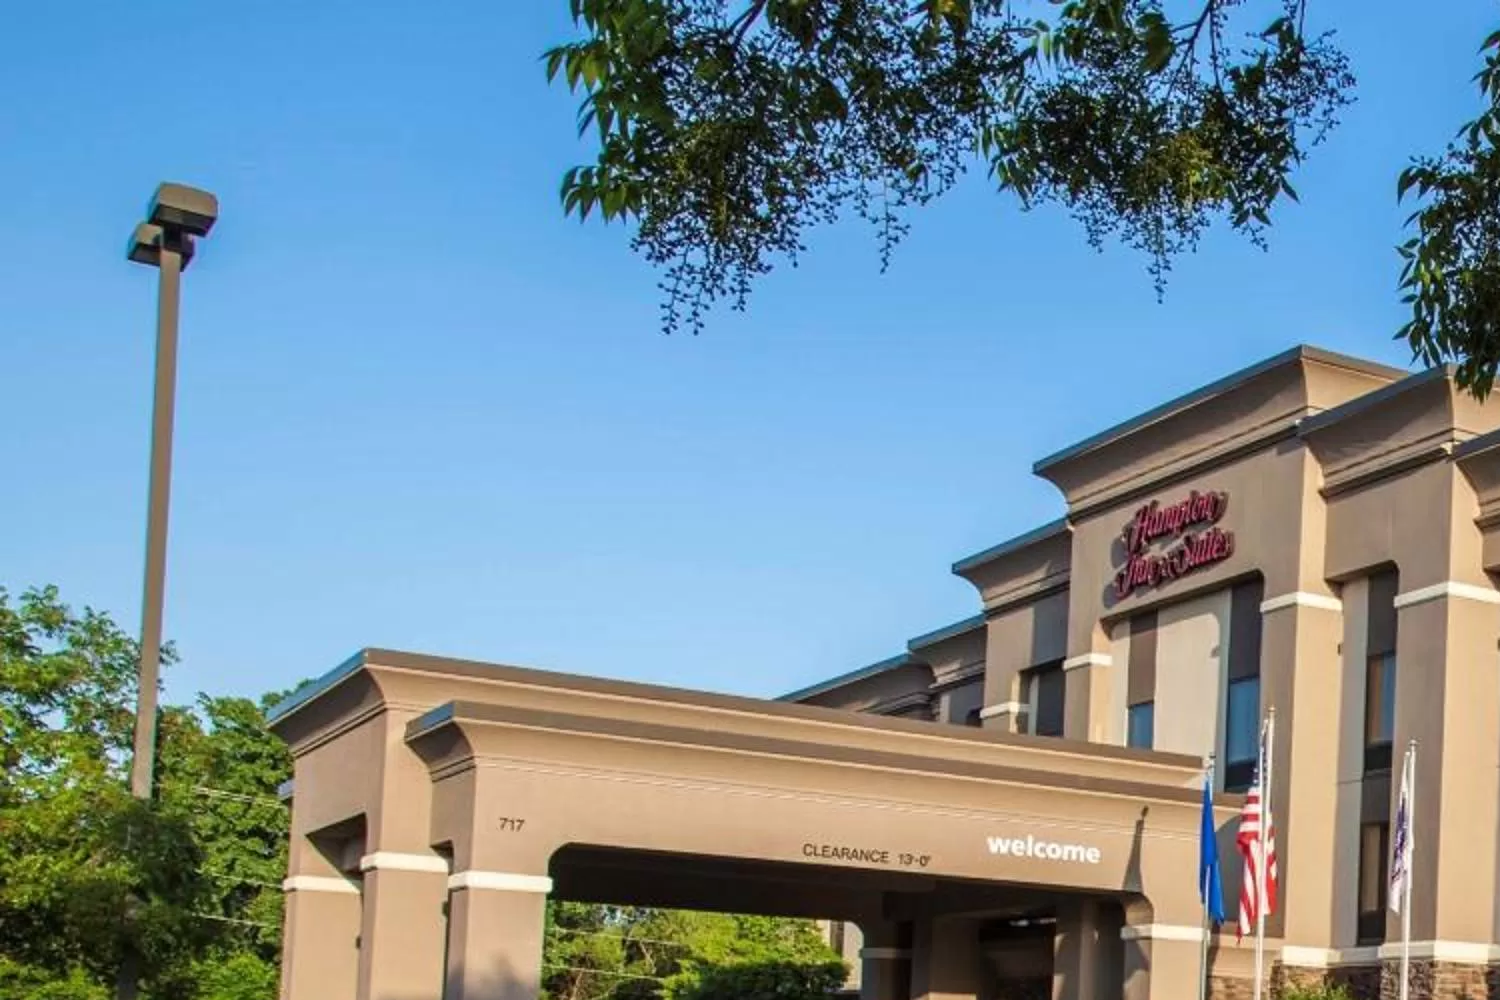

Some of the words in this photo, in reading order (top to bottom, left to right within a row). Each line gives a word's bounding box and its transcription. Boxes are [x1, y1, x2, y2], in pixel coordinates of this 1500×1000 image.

[1121, 490, 1230, 557] Hampton
[499, 817, 526, 832] 717
[802, 842, 890, 864] CLEARANCE
[986, 833, 1101, 864] welcome
